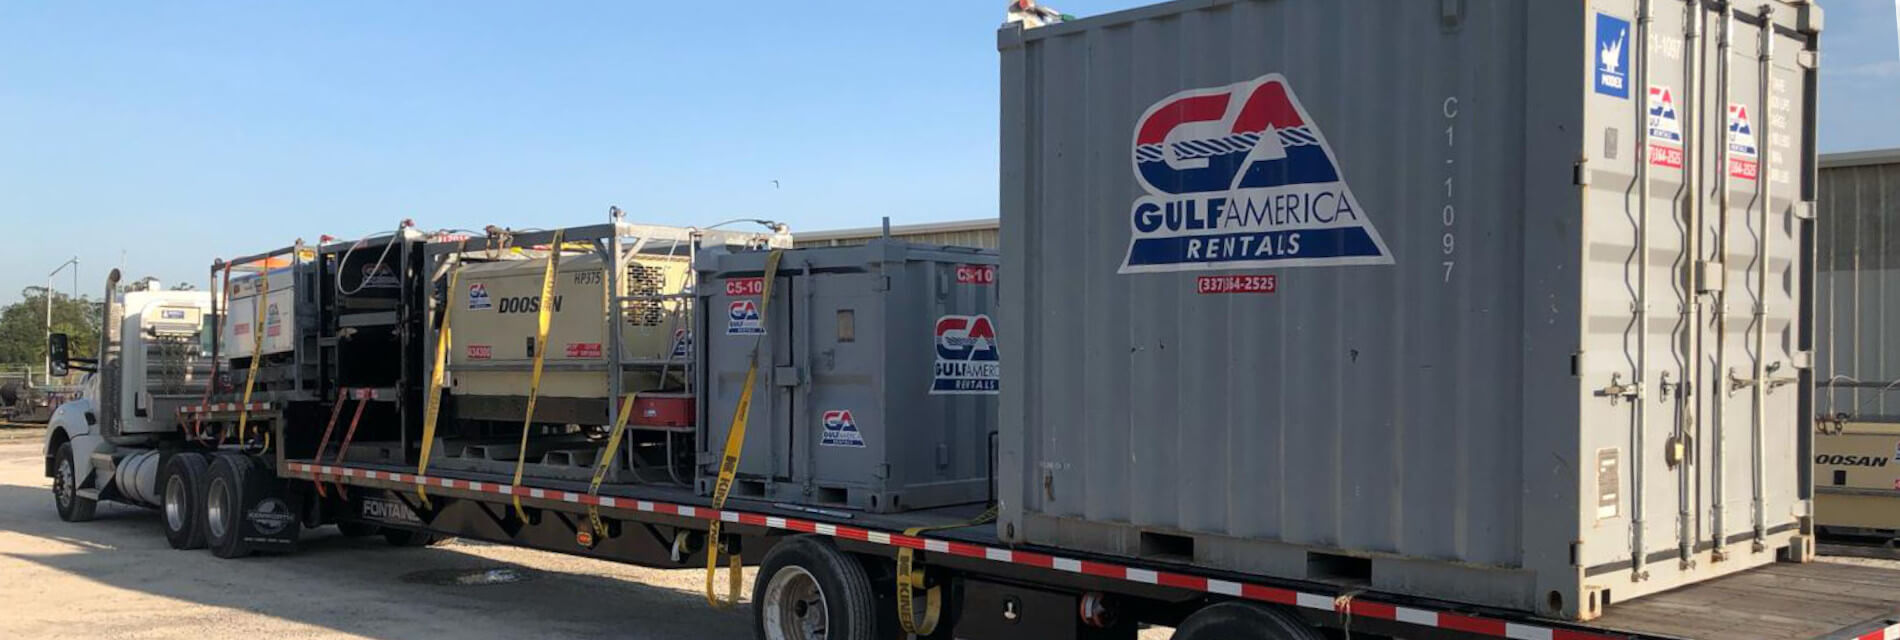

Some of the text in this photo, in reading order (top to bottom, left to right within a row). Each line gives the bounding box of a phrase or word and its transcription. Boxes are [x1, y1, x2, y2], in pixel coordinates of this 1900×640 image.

[1442, 96, 1459, 284] C1-1097
[1186, 233, 1300, 259] RENTALS
[574, 271, 601, 285] HP375
[498, 296, 563, 314] DOOSN
[1815, 454, 1889, 467] OOSAN
